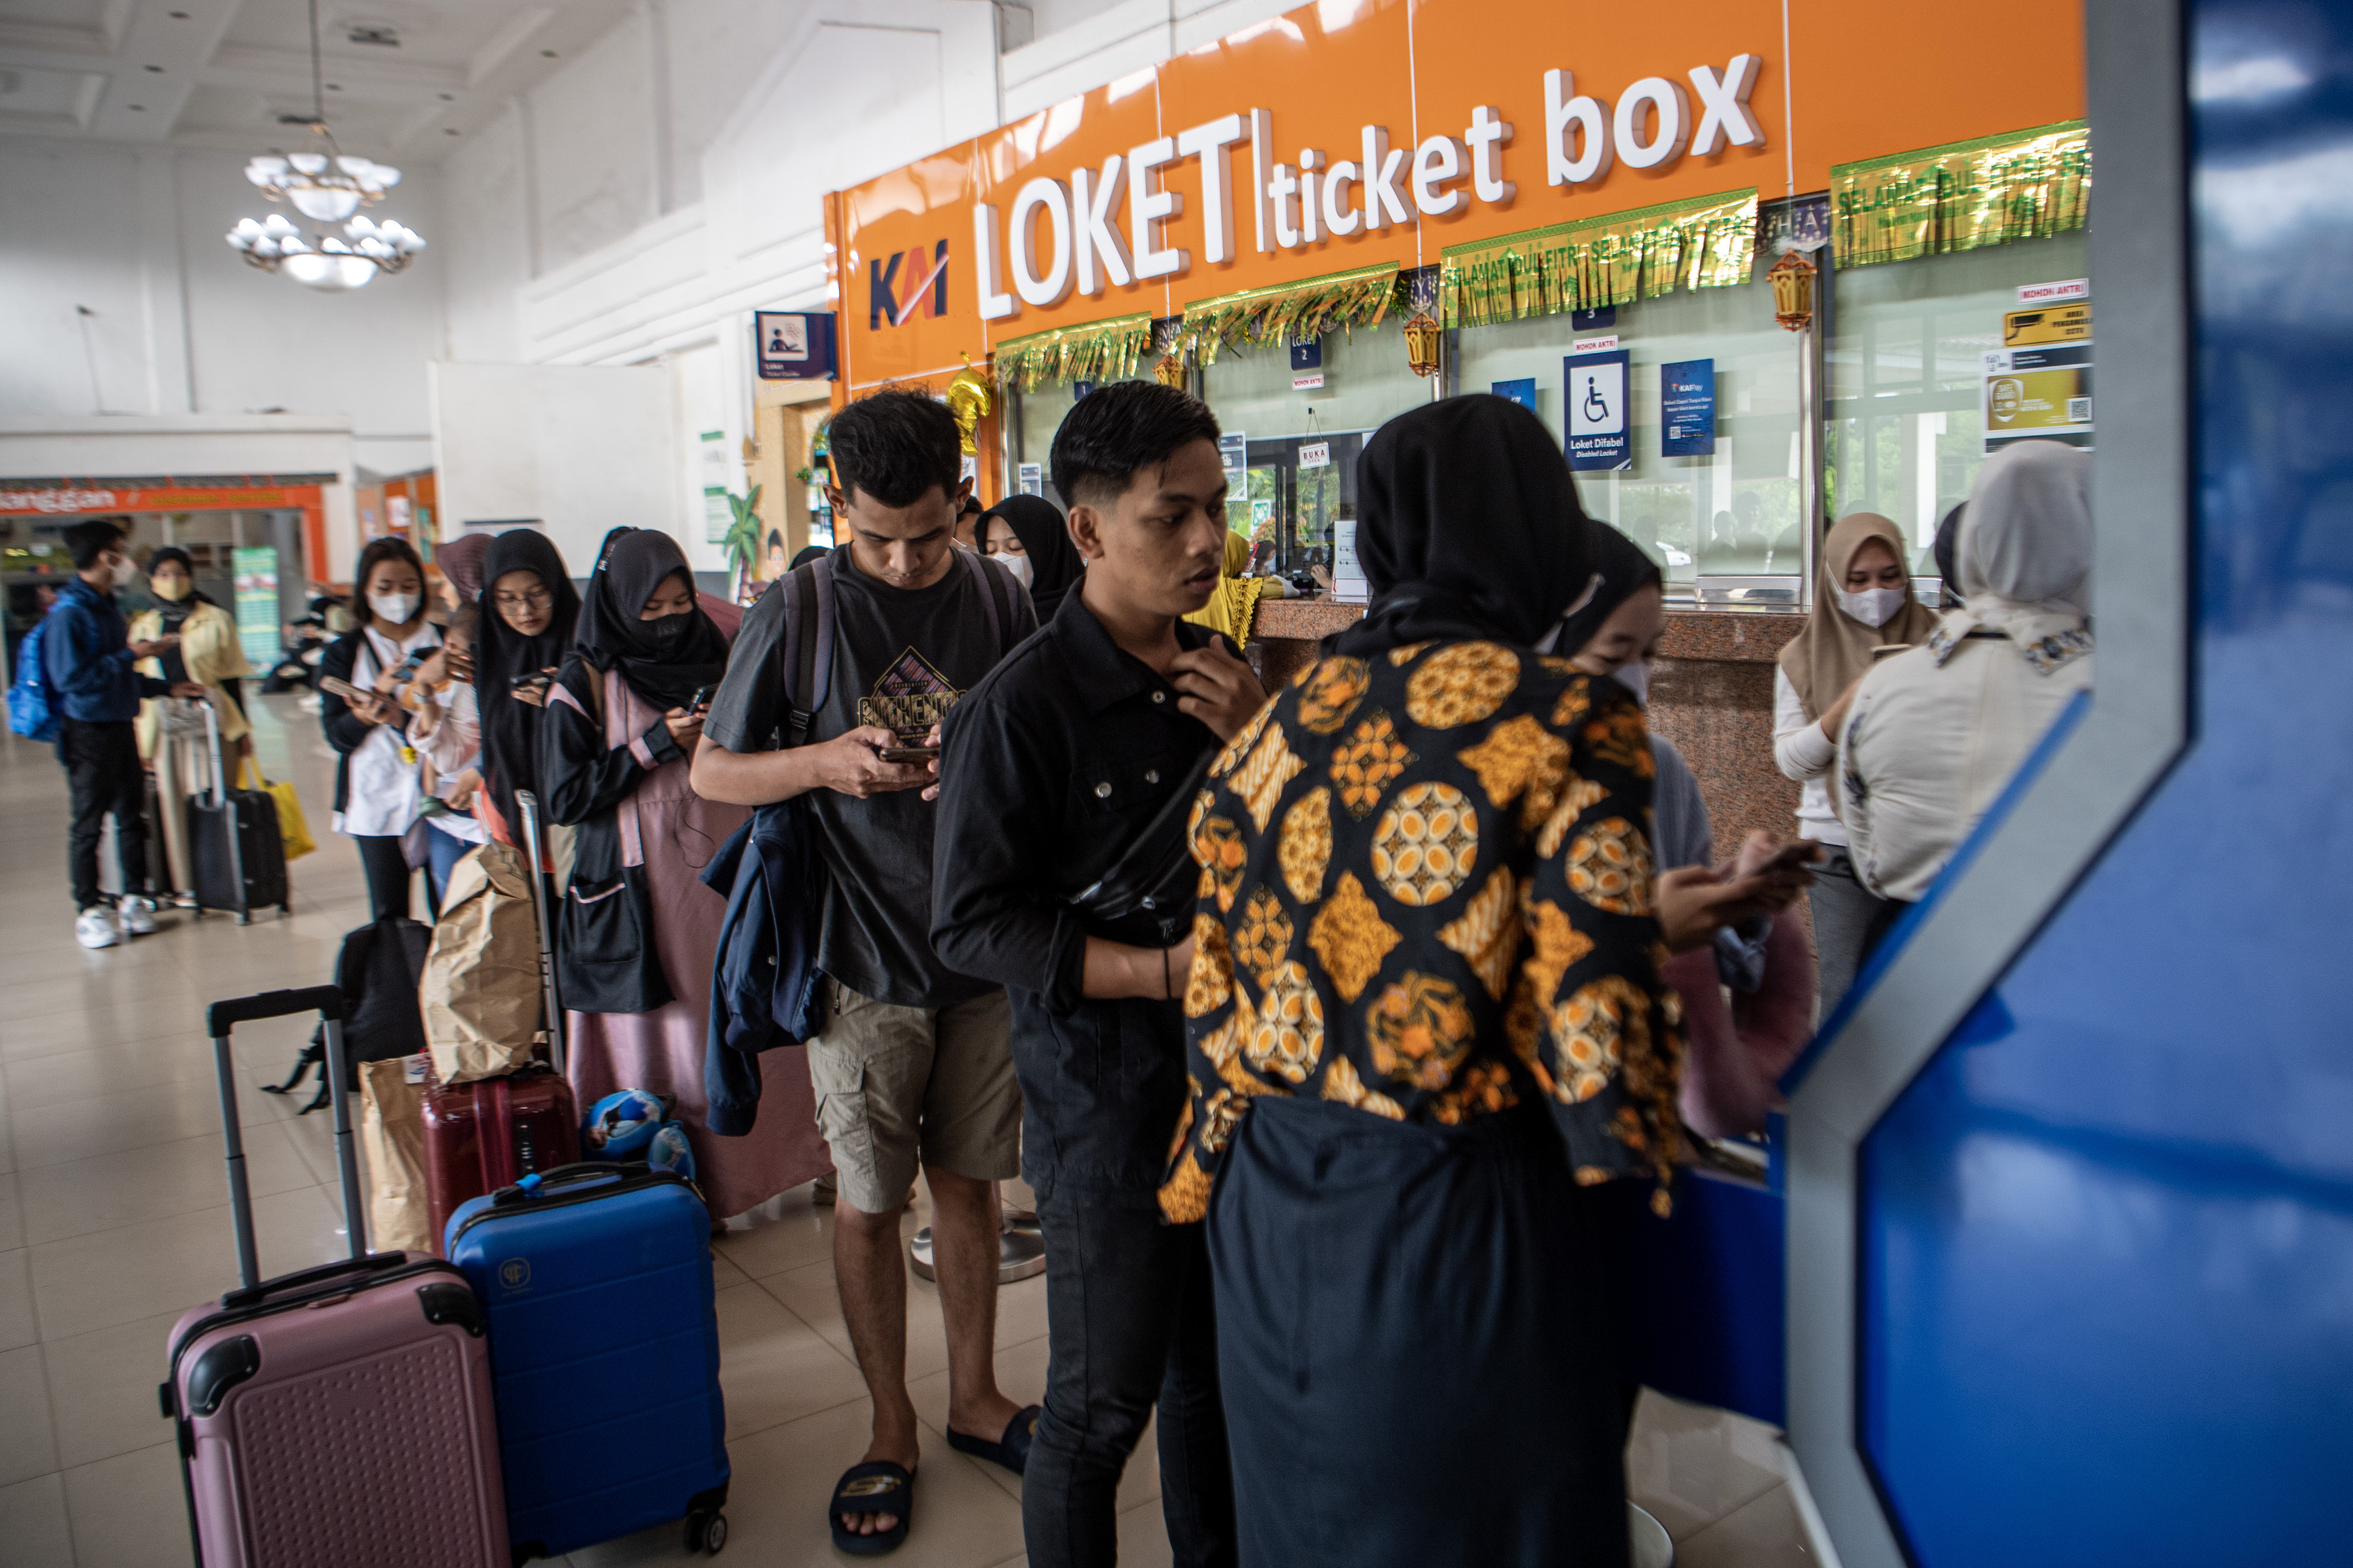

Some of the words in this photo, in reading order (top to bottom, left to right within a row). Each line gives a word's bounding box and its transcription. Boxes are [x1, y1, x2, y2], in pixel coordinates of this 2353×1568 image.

[973, 113, 1248, 321] LOKET
[1269, 105, 1513, 248] ticket
[1544, 54, 1762, 188] box
[1445, 259, 1505, 288] SELAMAT
[870, 239, 949, 331] KAI
[2023, 288, 2055, 299] MOHON
[2057, 284, 2084, 295] ANTRI
[1292, 332, 1317, 348] LOKE
[1577, 343, 1597, 351] MOHON
[1598, 340, 1615, 348] ANTRI
[1302, 349, 1308, 361] 2
[1571, 439, 1593, 449] Loket
[1594, 436, 1624, 448] Difabel
[1304, 449, 1325, 459] BUKA
[1576, 450, 1599, 458] Disabled
